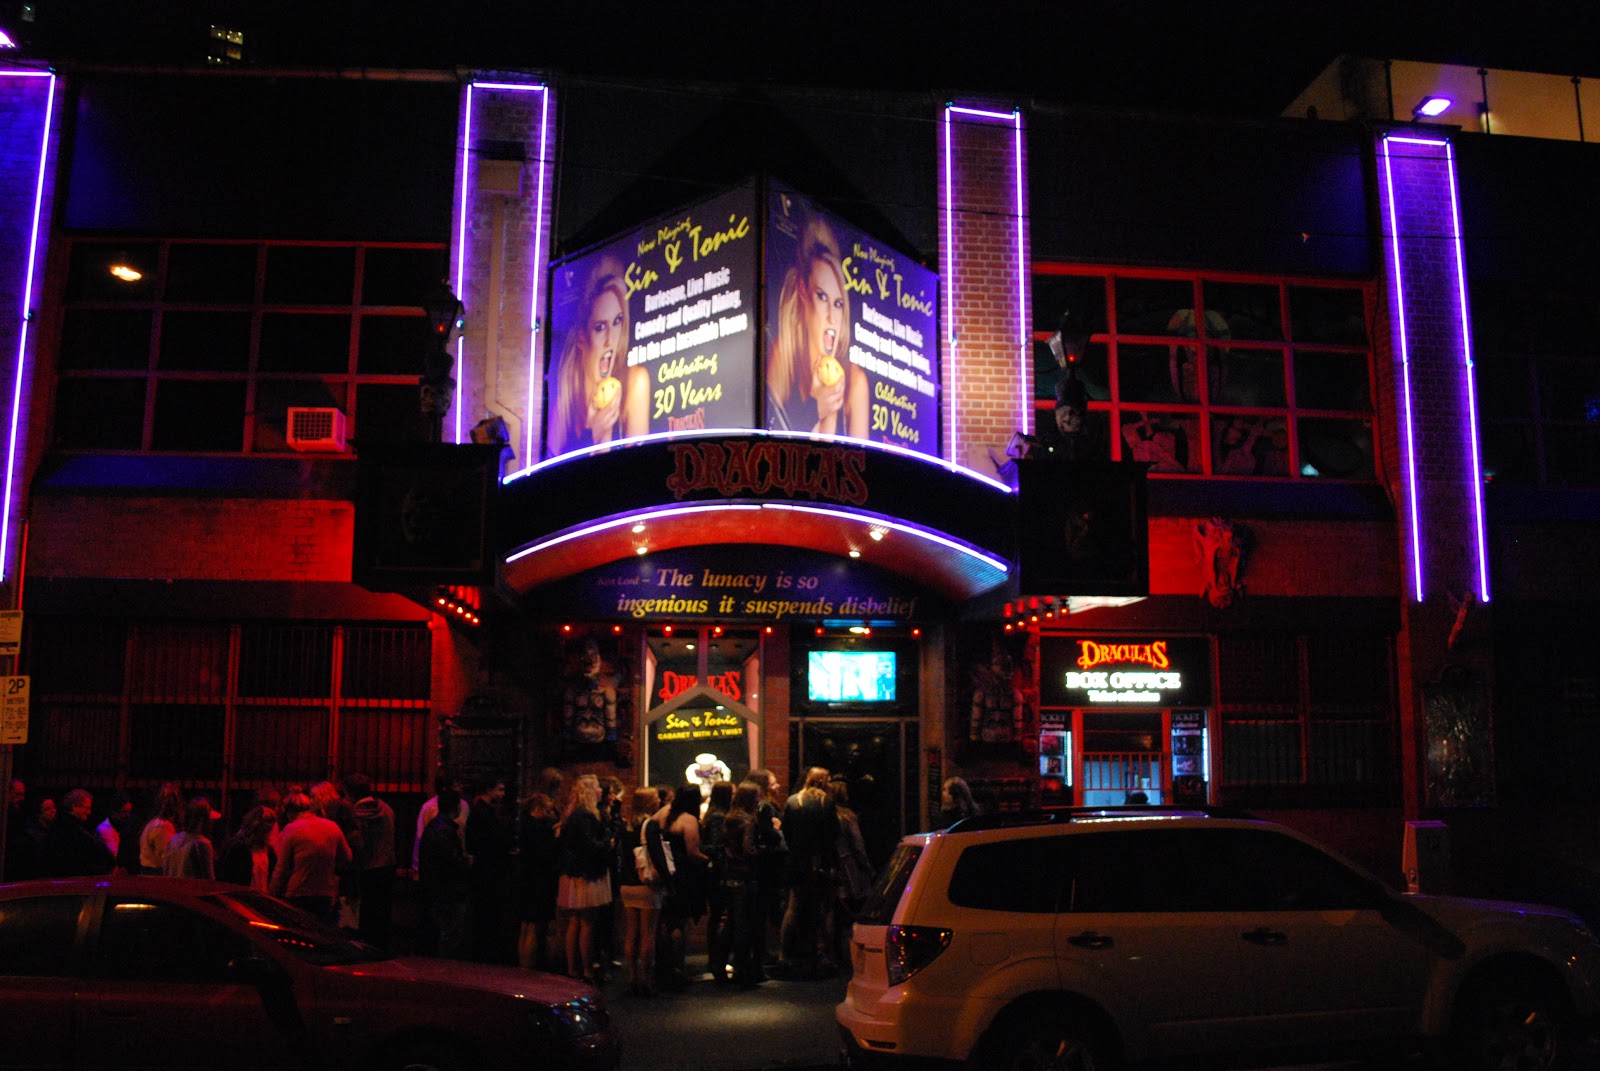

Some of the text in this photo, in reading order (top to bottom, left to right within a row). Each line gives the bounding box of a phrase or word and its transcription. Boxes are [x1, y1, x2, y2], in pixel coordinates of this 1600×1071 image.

[625, 261, 659, 301] Sin
[665, 240, 683, 274] &
[688, 213, 750, 262] Tonic
[687, 278, 703, 298] Live
[704, 267, 730, 292] Music
[841, 256, 933, 317] Sin & Tonic
[658, 353, 718, 383] Celebrating
[653, 379, 722, 419] 30 Years
[875, 381, 917, 420] Celebrating
[871, 403, 888, 431] 30
[891, 410, 919, 444] Years
[656, 568, 694, 588] The
[701, 568, 768, 594] lunacy
[776, 570, 792, 589] is
[797, 575, 819, 590] so
[616, 594, 918, 620] ingenious it suspends disbelief
[8, 678, 26, 694] 2P
[1065, 671, 1182, 689] BOX OFFICE
[657, 731, 691, 741] CABARET
[692, 730, 711, 738] WITH
[720, 728, 743, 736] TWIST
[665, 711, 739, 730] Sin & Tonic
